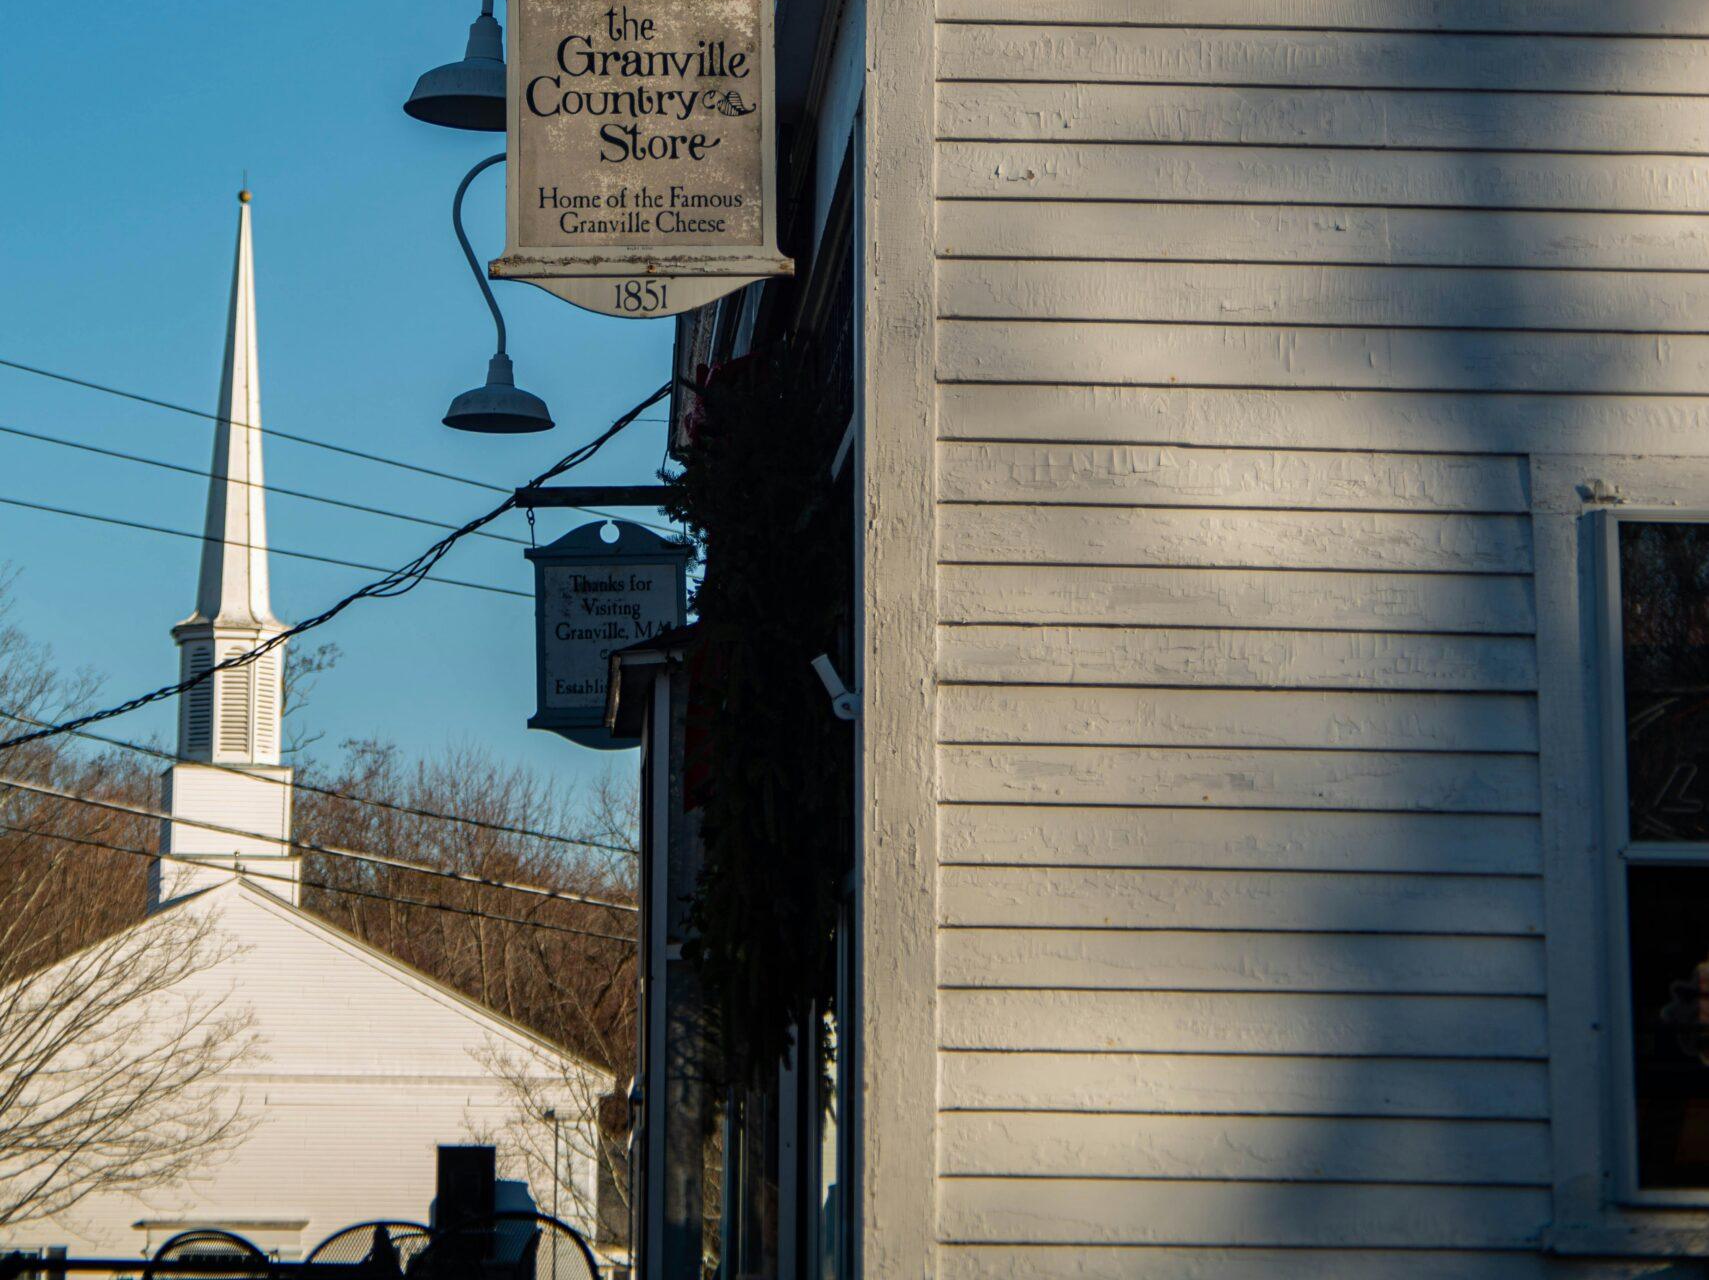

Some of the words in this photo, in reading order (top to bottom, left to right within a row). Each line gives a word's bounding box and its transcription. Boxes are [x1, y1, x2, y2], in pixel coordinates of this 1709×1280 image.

[604, 5, 655, 42] the
[557, 34, 750, 79] Granville
[525, 75, 698, 120] Country
[599, 123, 721, 163] Store
[538, 187, 602, 209] Home
[606, 187, 628, 209] of
[634, 189, 664, 209] the
[669, 187, 743, 209] Famous
[559, 211, 651, 234] Granville
[655, 211, 726, 234] Cheese
[614, 279, 668, 312] 1851
[568, 574, 625, 592] Thanks
[629, 573, 653, 592] for
[582, 598, 641, 620] Visiting
[555, 621, 630, 641] Granville,
